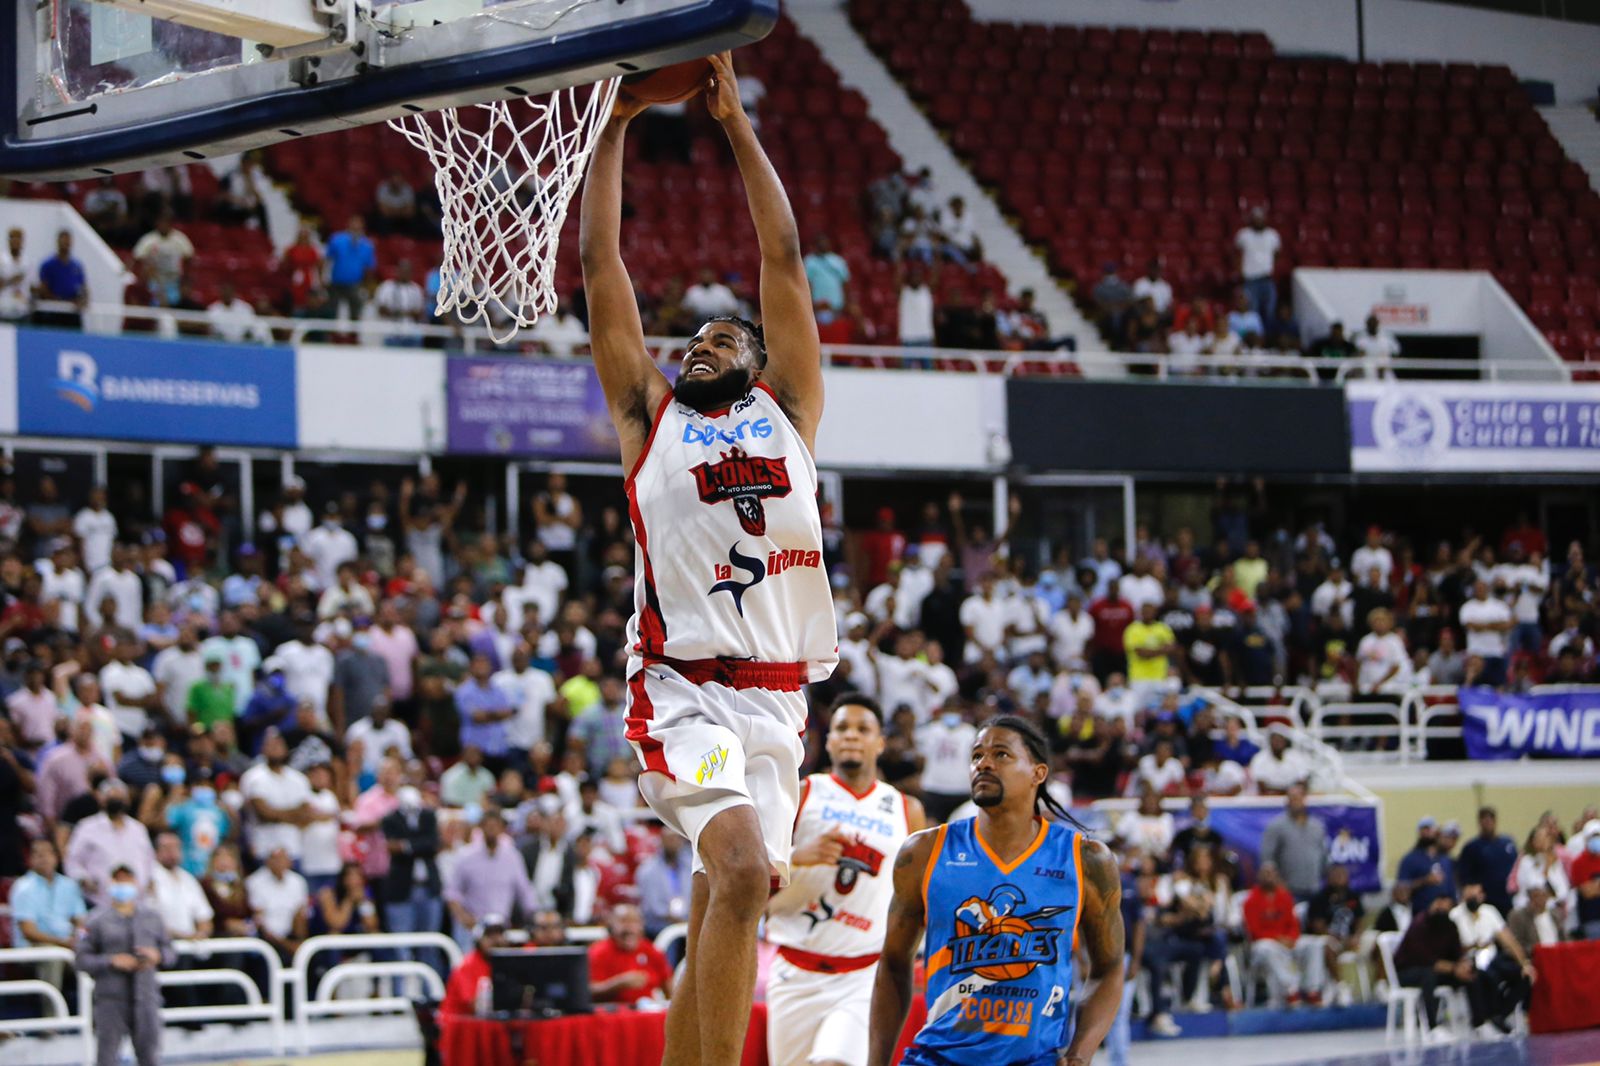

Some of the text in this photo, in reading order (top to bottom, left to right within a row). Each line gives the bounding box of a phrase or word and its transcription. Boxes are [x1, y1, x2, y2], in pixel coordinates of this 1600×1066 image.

[1455, 400, 1532, 423] Cuida
[1542, 401, 1567, 424] el
[682, 417, 773, 446] beris
[1456, 422, 1534, 446] Cuida
[1544, 423, 1568, 446] el
[741, 484, 772, 492] DOMINGO
[714, 563, 732, 581] la
[821, 805, 894, 837] betcris
[948, 928, 1064, 975] TITANES
[981, 985, 1039, 999] DISTRITO
